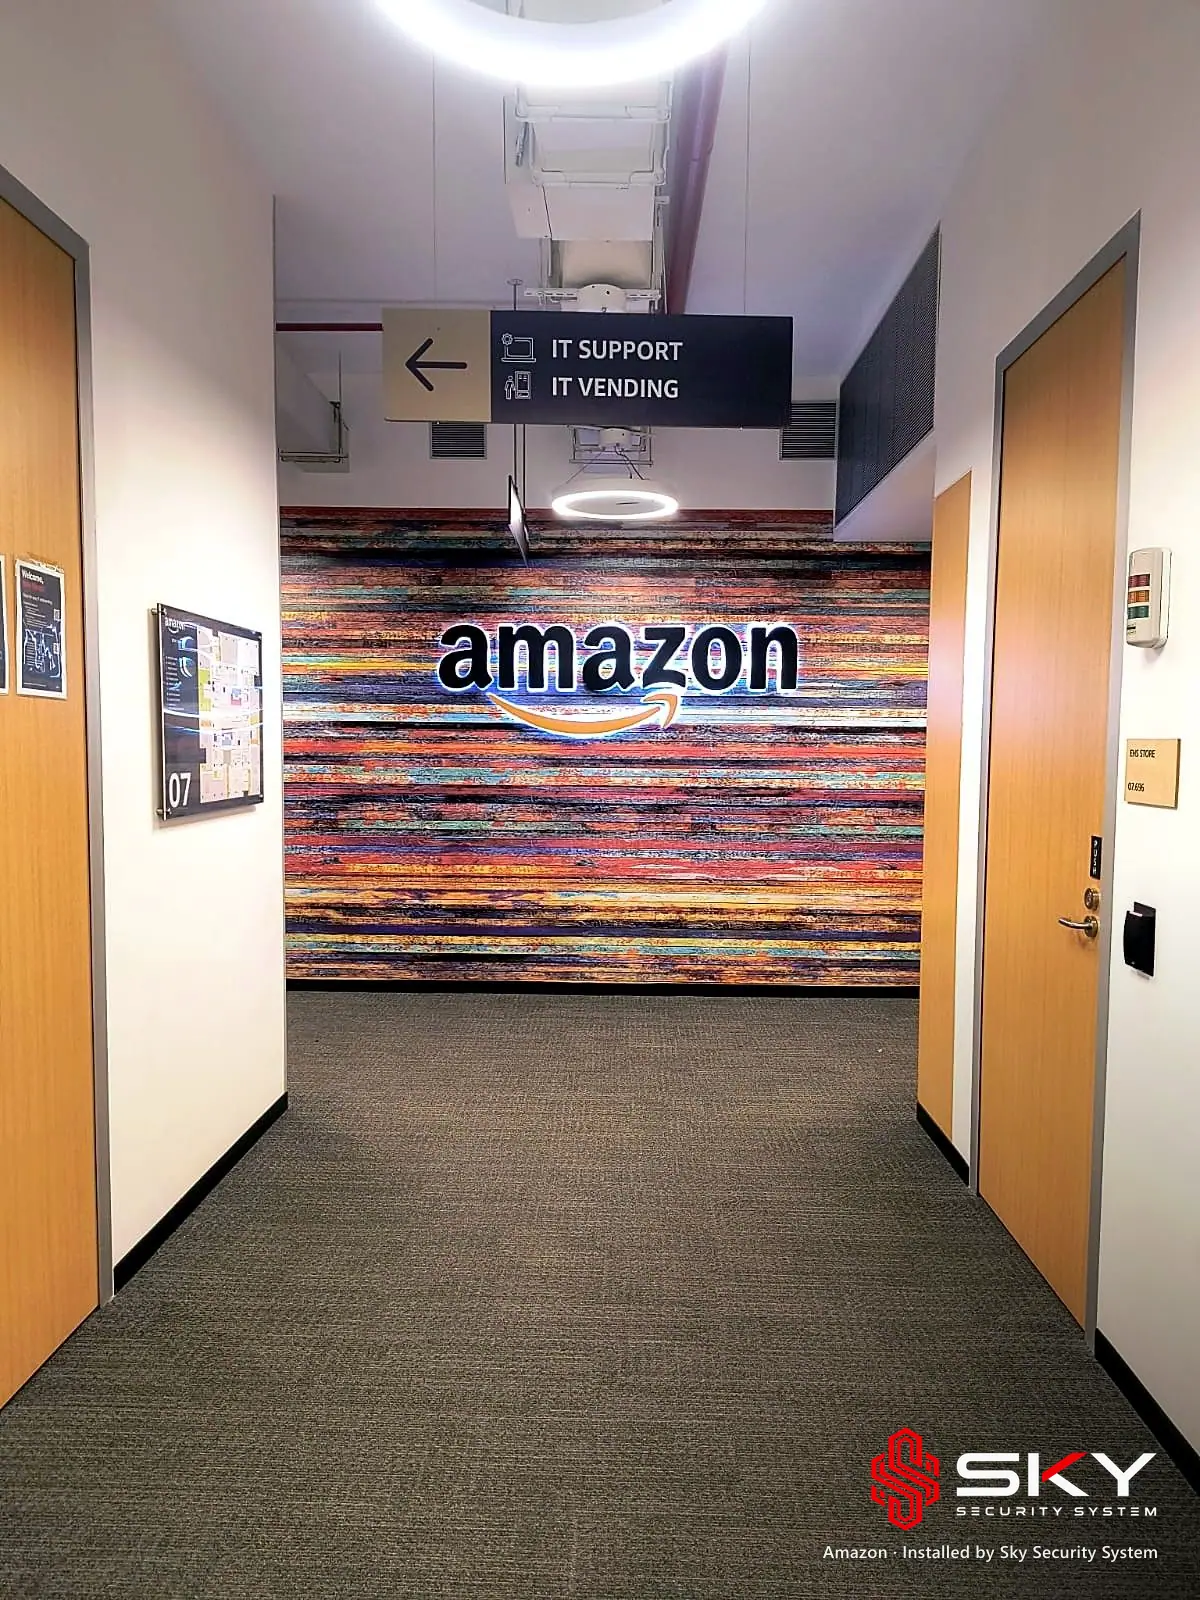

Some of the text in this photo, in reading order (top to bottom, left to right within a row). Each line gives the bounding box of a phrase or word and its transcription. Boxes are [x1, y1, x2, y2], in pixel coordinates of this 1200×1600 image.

[552, 339, 683, 361] IT SUPPORT
[552, 377, 679, 399] IT VENDING
[437, 623, 799, 692] amazon
[168, 772, 192, 808] 07
